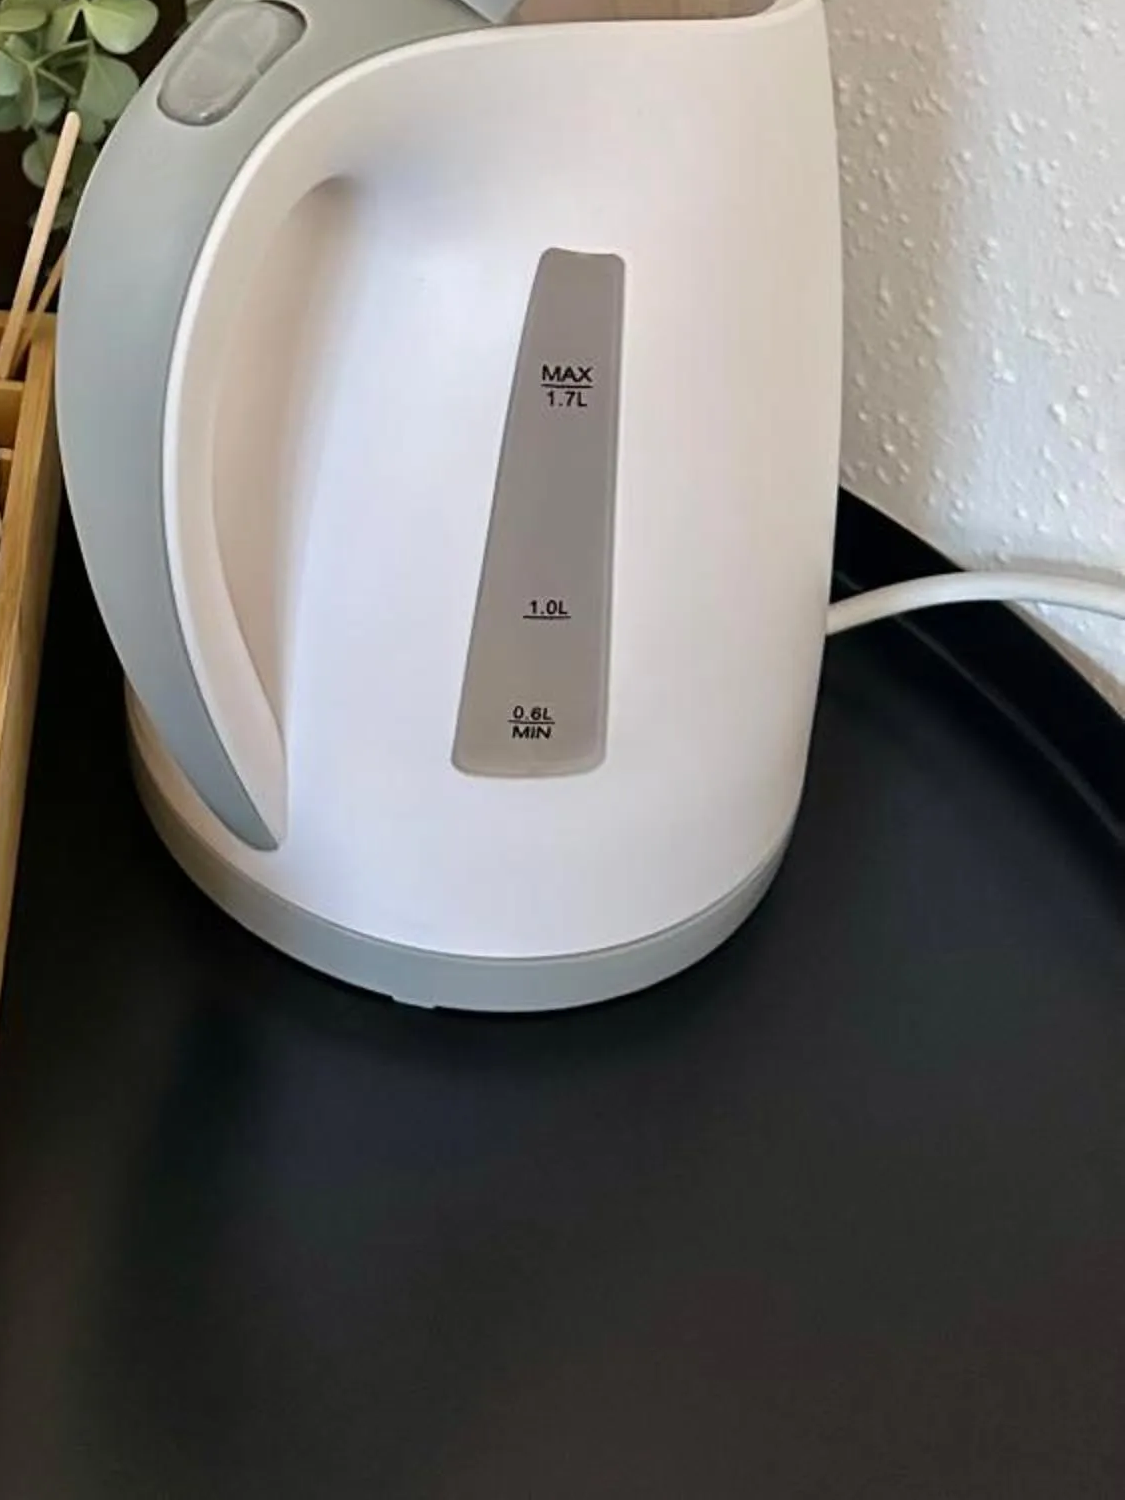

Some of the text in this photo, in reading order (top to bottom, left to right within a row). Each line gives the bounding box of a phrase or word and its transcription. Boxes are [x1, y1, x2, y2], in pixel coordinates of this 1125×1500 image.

[541, 363, 594, 383] MAX
[546, 390, 588, 407] 1.7L
[529, 599, 568, 615] 1.0L
[512, 705, 554, 721] 0.6L
[511, 725, 552, 740] MIN
